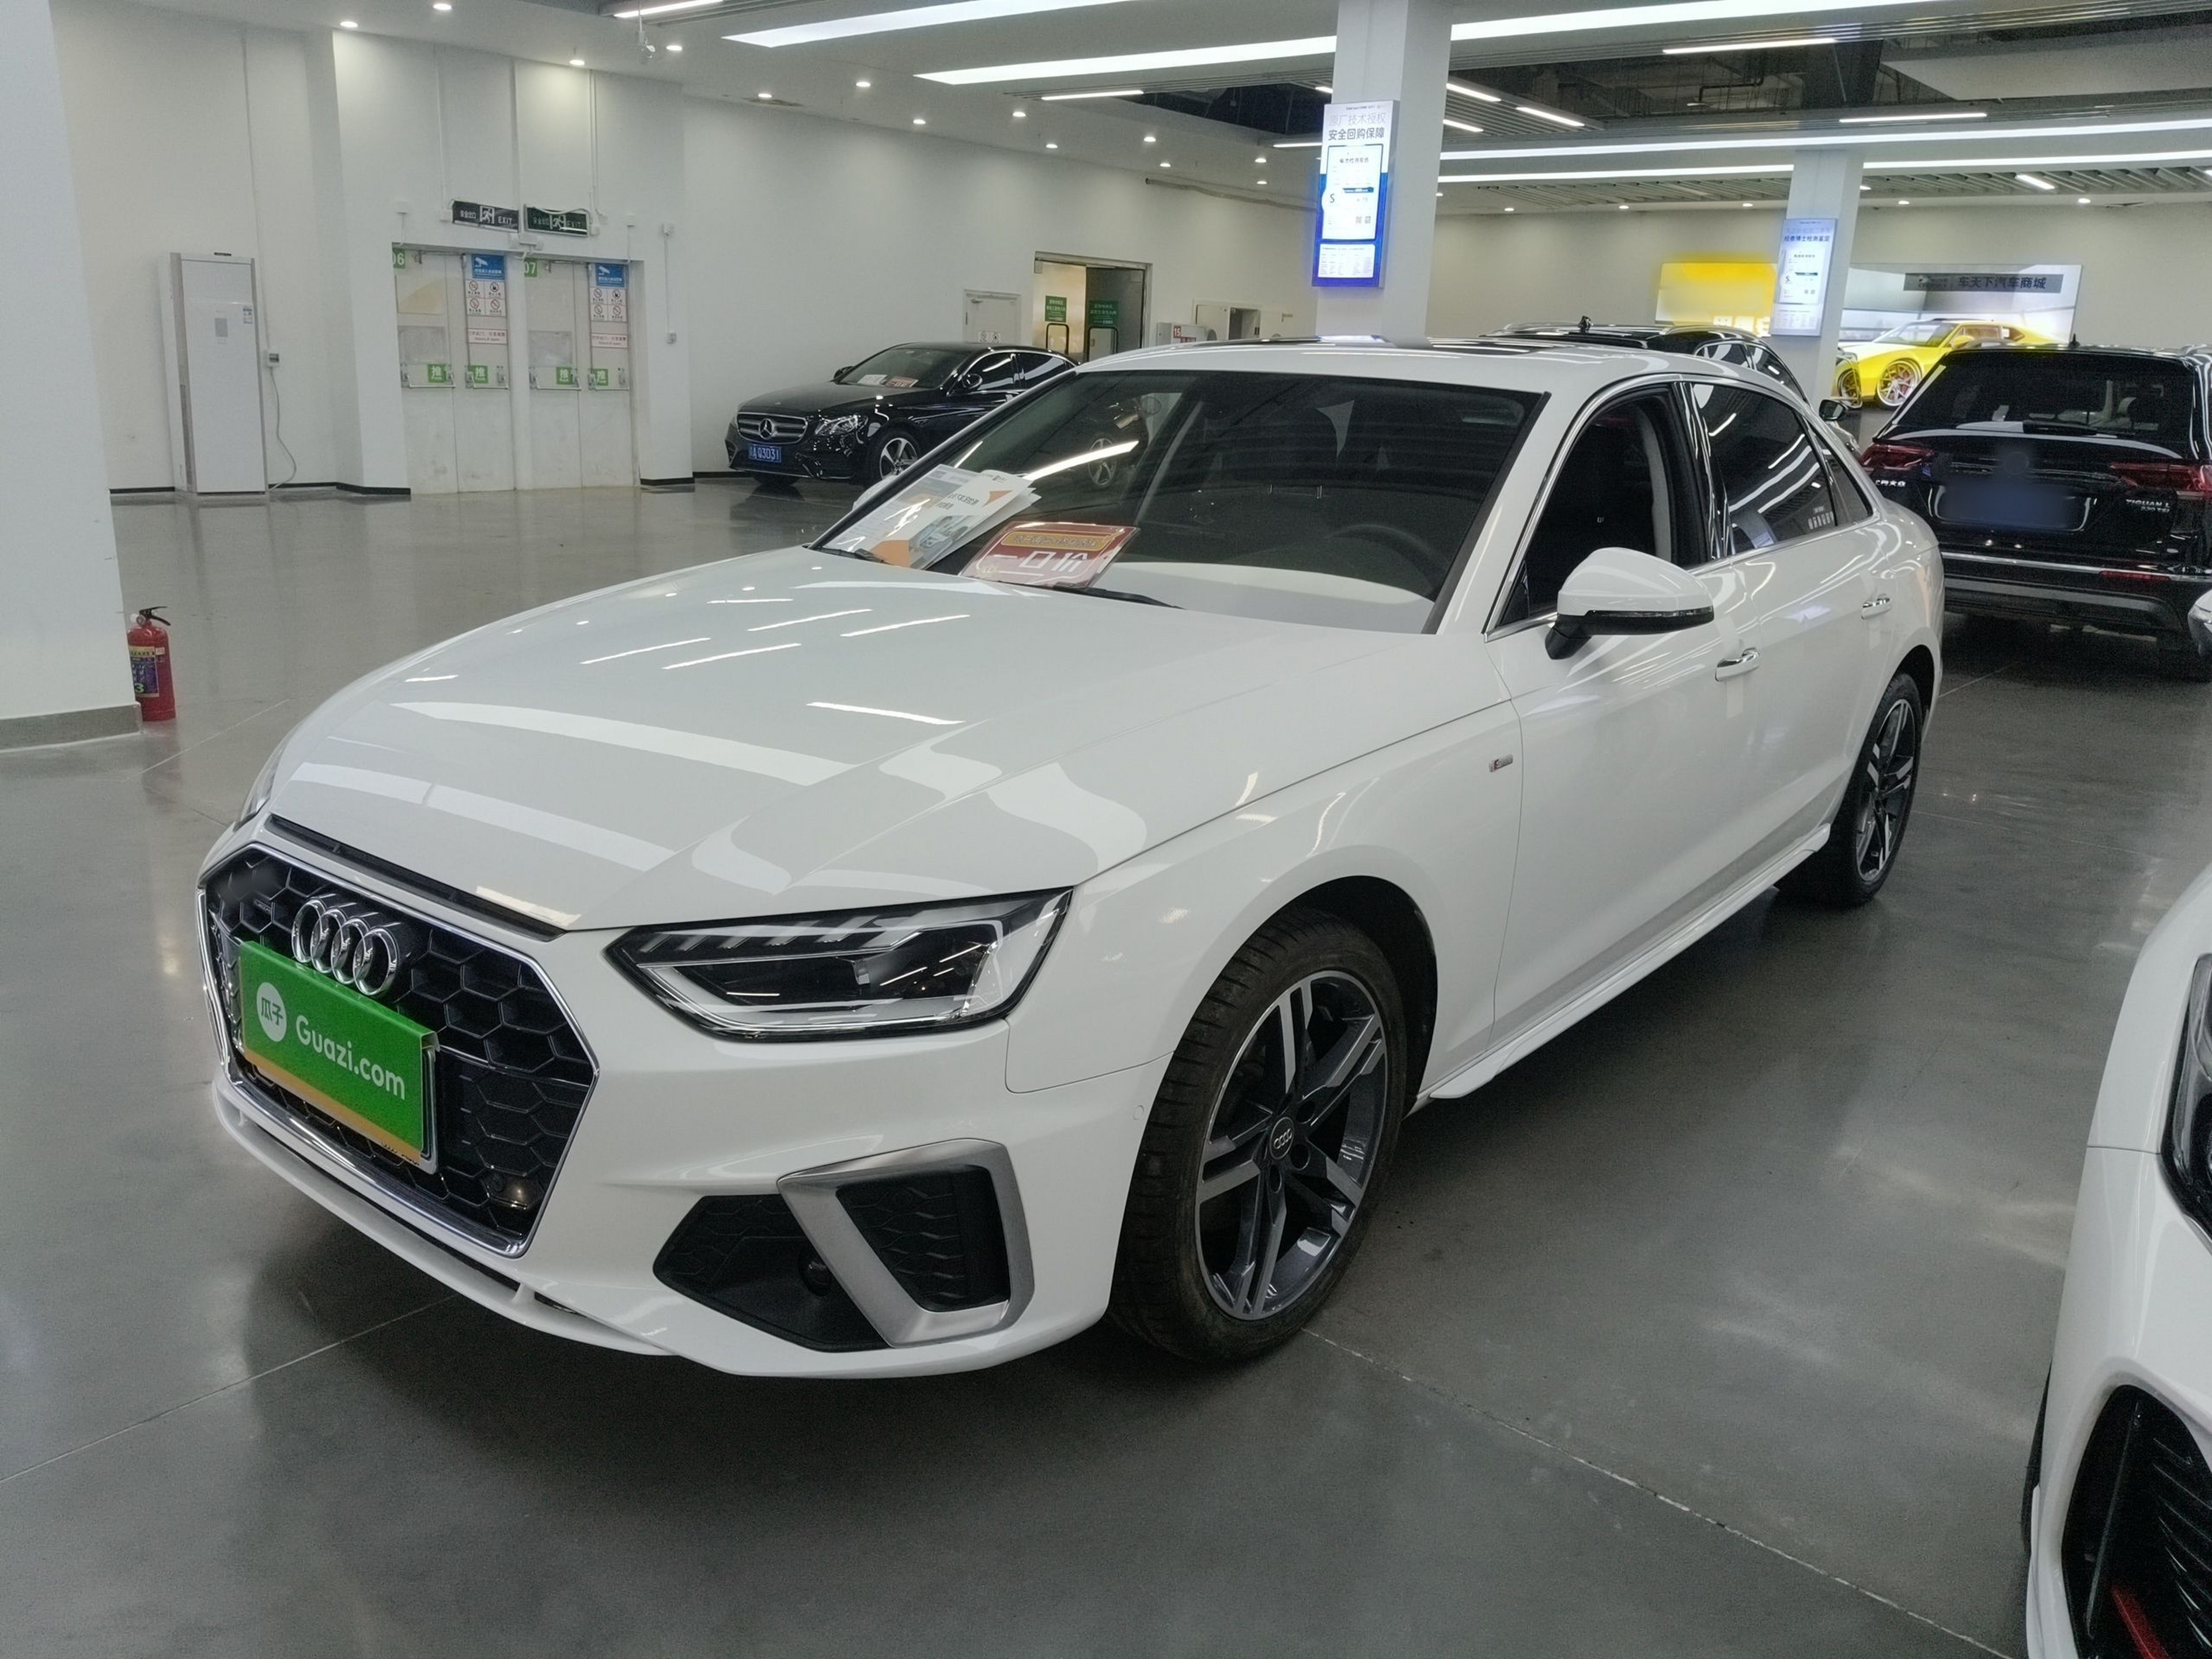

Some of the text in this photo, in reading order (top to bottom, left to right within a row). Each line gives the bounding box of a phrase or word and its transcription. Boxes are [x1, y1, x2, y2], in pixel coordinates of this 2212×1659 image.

[1328, 127, 1384, 141] 安全回购保障
[498, 217, 512, 225] EXIT
[1959, 276, 2047, 289] 车天下汽车商城
[1174, 327, 1181, 337] 15
[993, 551, 1088, 573] 一口价
[261, 996, 284, 1027] 瓜子
[296, 1015, 406, 1100] Guazi.com
